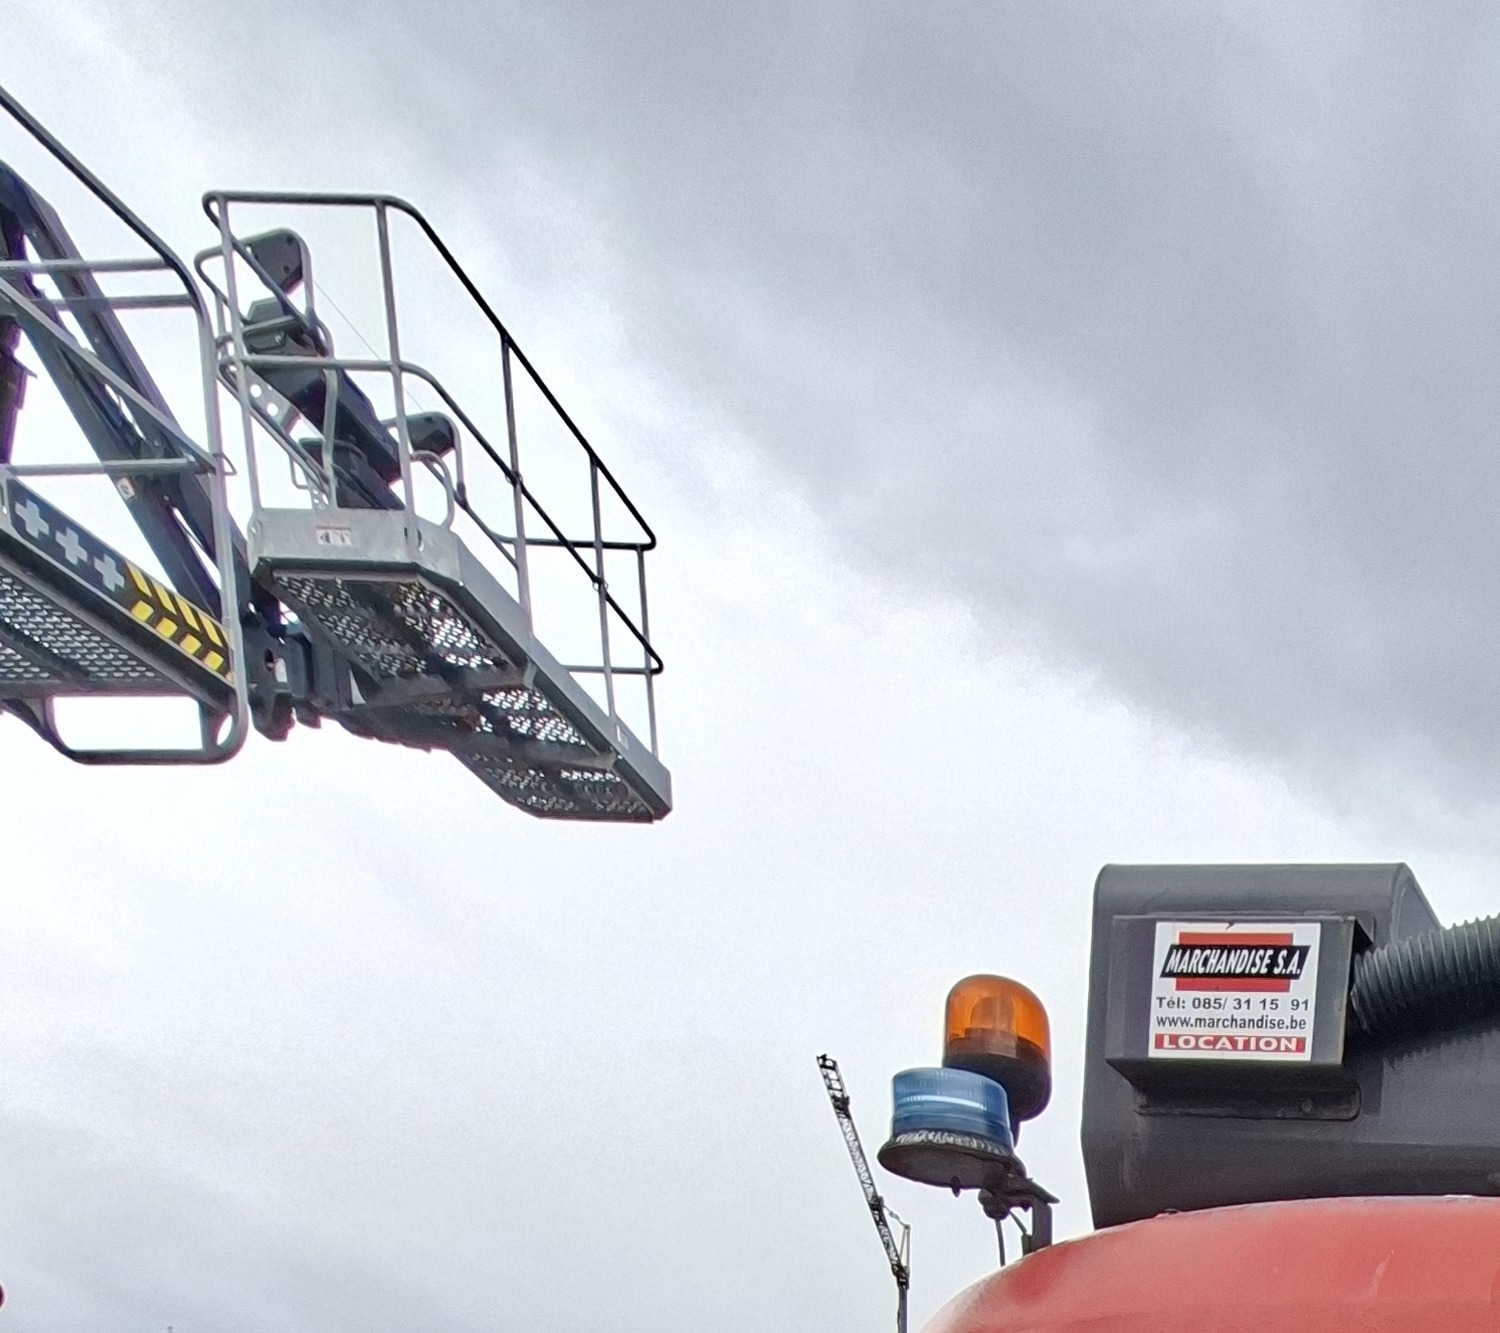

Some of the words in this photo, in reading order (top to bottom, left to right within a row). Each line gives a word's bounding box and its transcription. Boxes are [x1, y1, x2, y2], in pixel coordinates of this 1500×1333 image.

[1165, 948, 1272, 974] MARCHANDISE
[1273, 949, 1301, 975] S.A.
[1156, 995, 1186, 1010] Tél:
[1191, 997, 1228, 1011] 085/
[1233, 998, 1251, 1011] 31
[1259, 998, 1279, 1011] 15
[1290, 998, 1309, 1011] 91
[1156, 1014, 1307, 1030] www.marchandise.be
[1162, 1034, 1298, 1051] LOCATION
